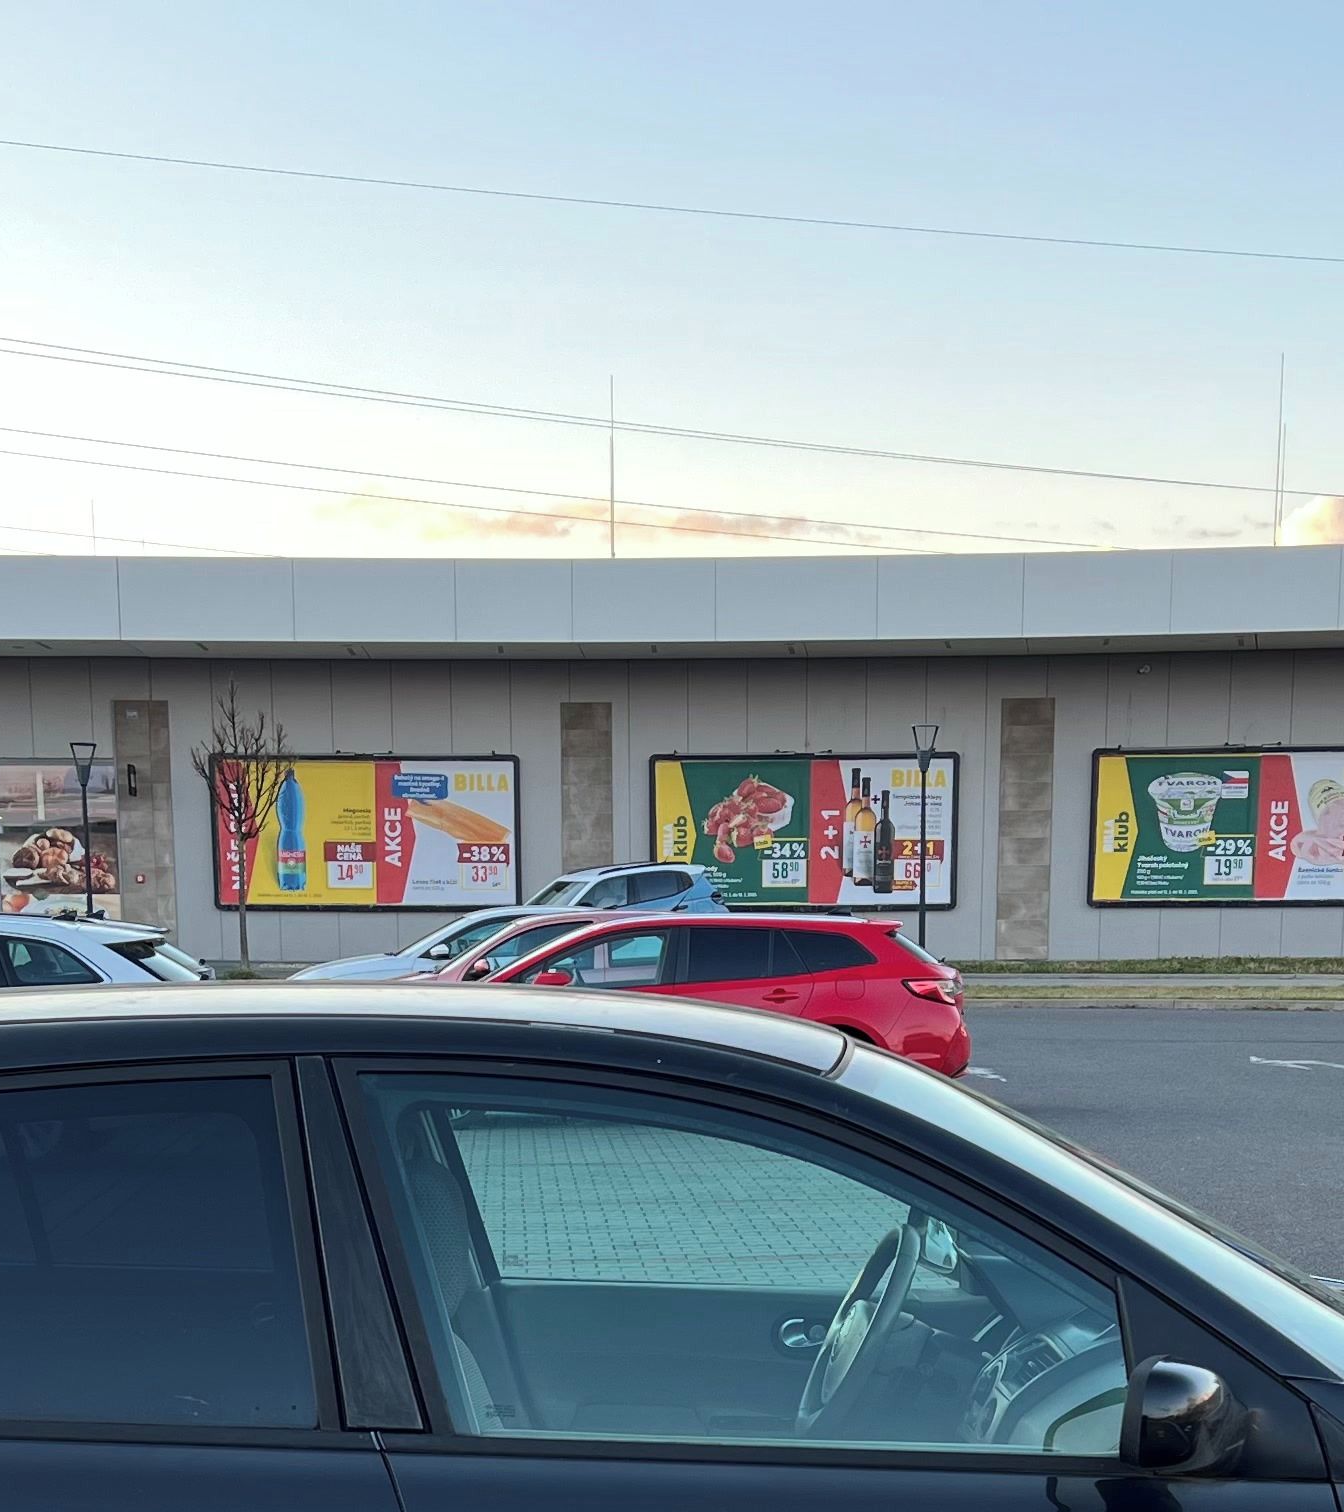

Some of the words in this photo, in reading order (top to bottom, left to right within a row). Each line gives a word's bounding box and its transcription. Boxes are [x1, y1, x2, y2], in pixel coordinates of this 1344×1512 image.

[454, 774, 509, 792] BILLA
[384, 807, 403, 867] AKCE
[674, 816, 687, 856] klub
[1114, 811, 1129, 852] klub
[1269, 800, 1289, 862] AKCE
[337, 843, 362, 852] NAŠE
[462, 846, 506, 862] -38%
[764, 843, 806, 858] -34%
[1206, 840, 1252, 855] -29%
[336, 852, 363, 861] CENA
